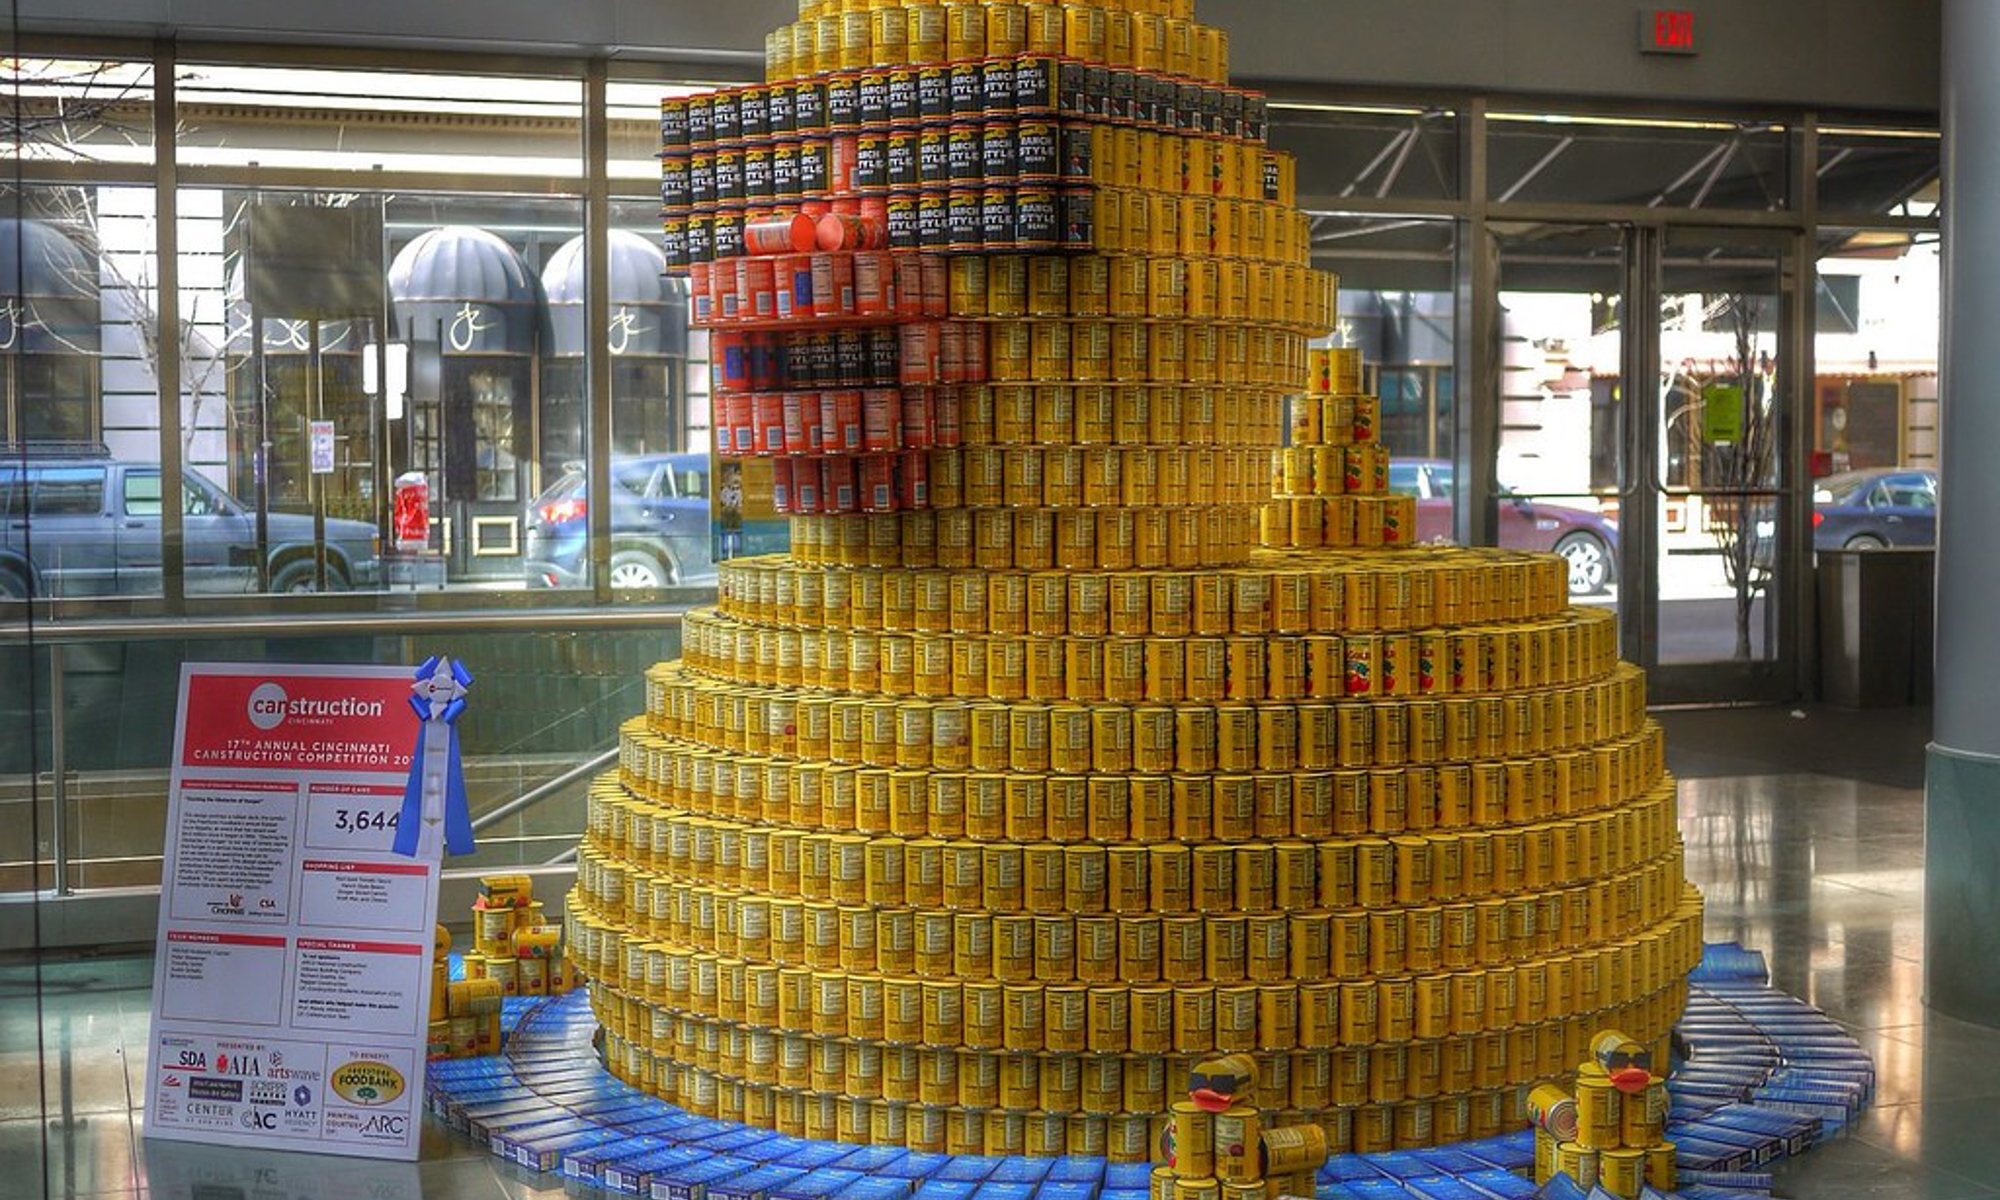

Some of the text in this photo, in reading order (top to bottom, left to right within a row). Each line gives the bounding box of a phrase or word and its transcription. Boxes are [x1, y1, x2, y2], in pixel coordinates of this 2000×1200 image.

[1655, 10, 1692, 49] EXIT
[255, 741, 306, 751] ANNUAL
[312, 742, 390, 753] CINCINNATI
[194, 750, 414, 766] CANSTRUCTION COMPETITION 20
[179, 1050, 206, 1067] SDA
[229, 1055, 260, 1076] AIA
[339, 1075, 398, 1090] FOODBANK
[187, 1103, 233, 1116] CENTER
[285, 1110, 317, 1119] HYATT
